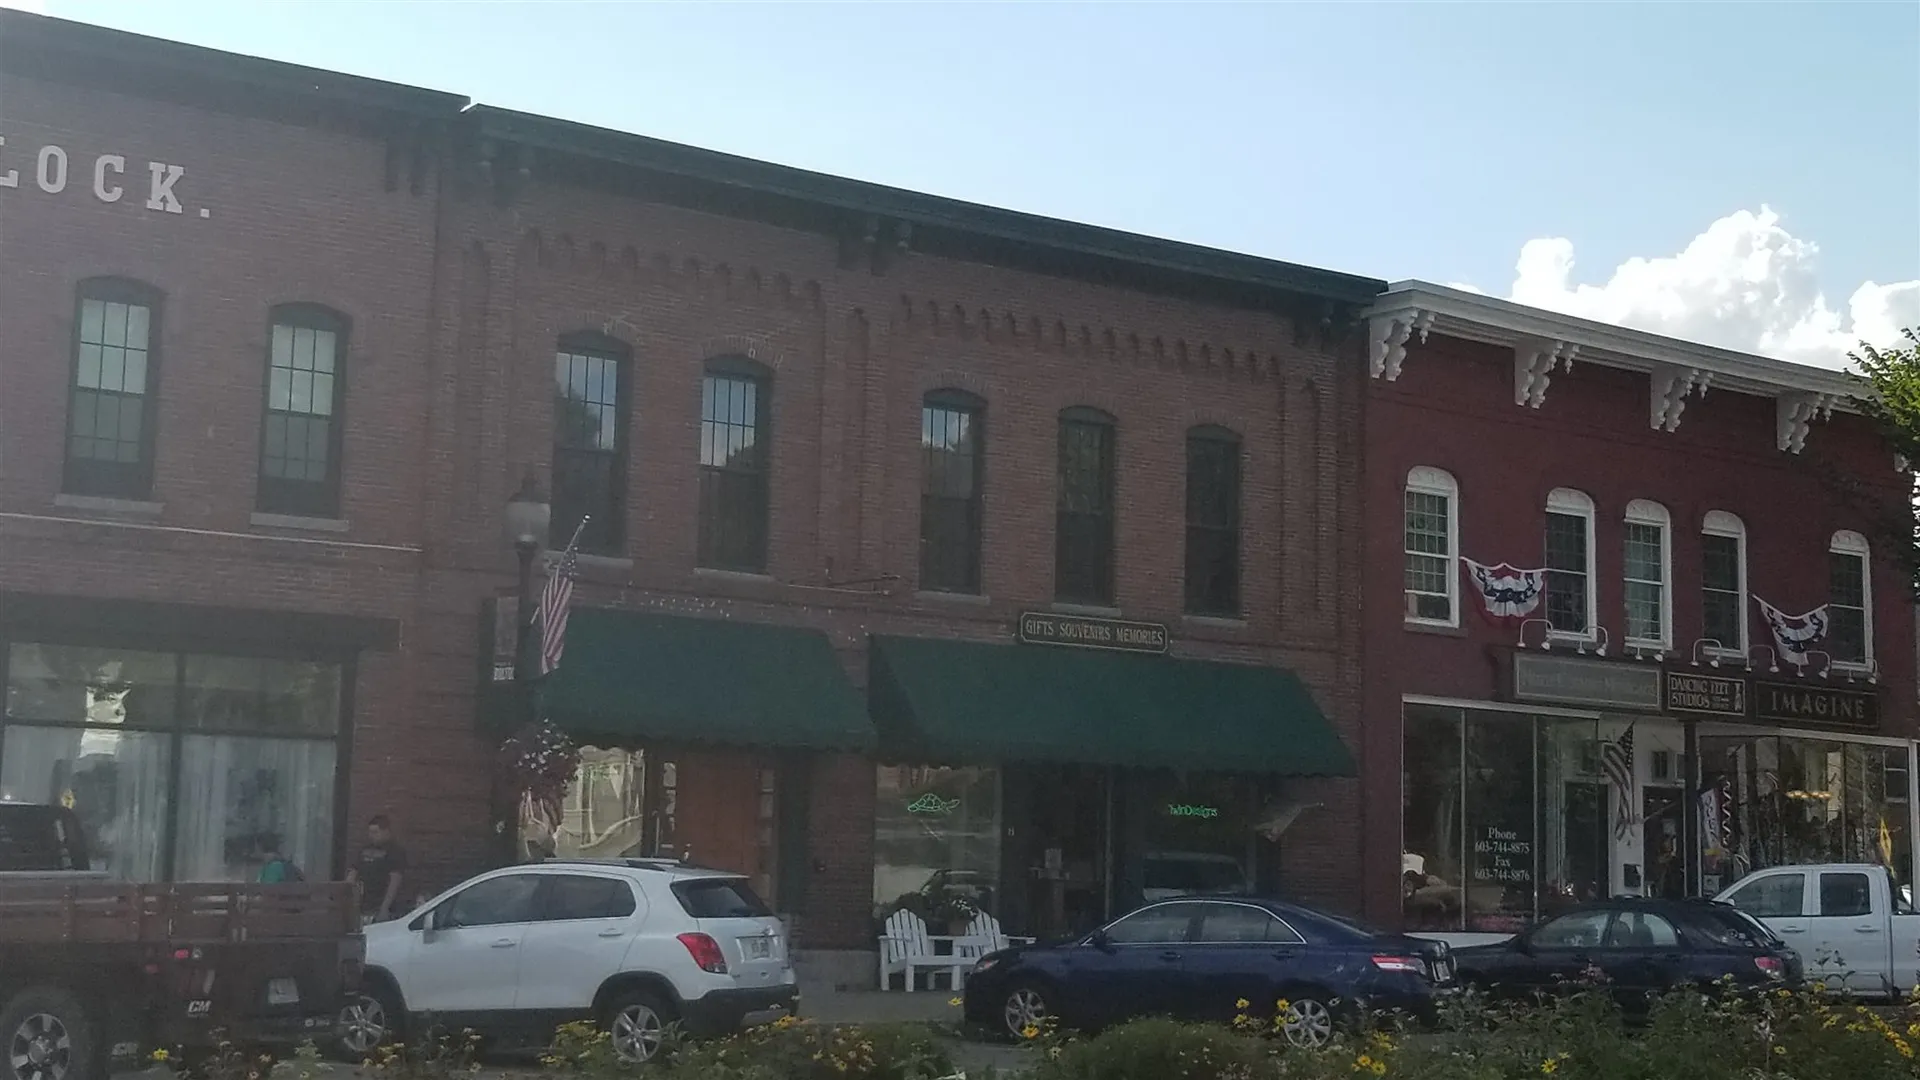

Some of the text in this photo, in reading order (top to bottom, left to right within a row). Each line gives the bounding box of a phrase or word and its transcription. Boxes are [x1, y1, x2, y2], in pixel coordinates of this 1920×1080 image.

[1025, 619, 1164, 645] GIFTS SOUVENIRS MEMORIES
[1671, 692, 1710, 708] STUDIOS
[1771, 691, 1865, 719] IMAGINE
[1488, 826, 1517, 840] Phone
[1474, 841, 1530, 854] 603-744-8875
[1494, 856, 1511, 867] Fax
[1474, 868, 1530, 881] 603-744-8876
